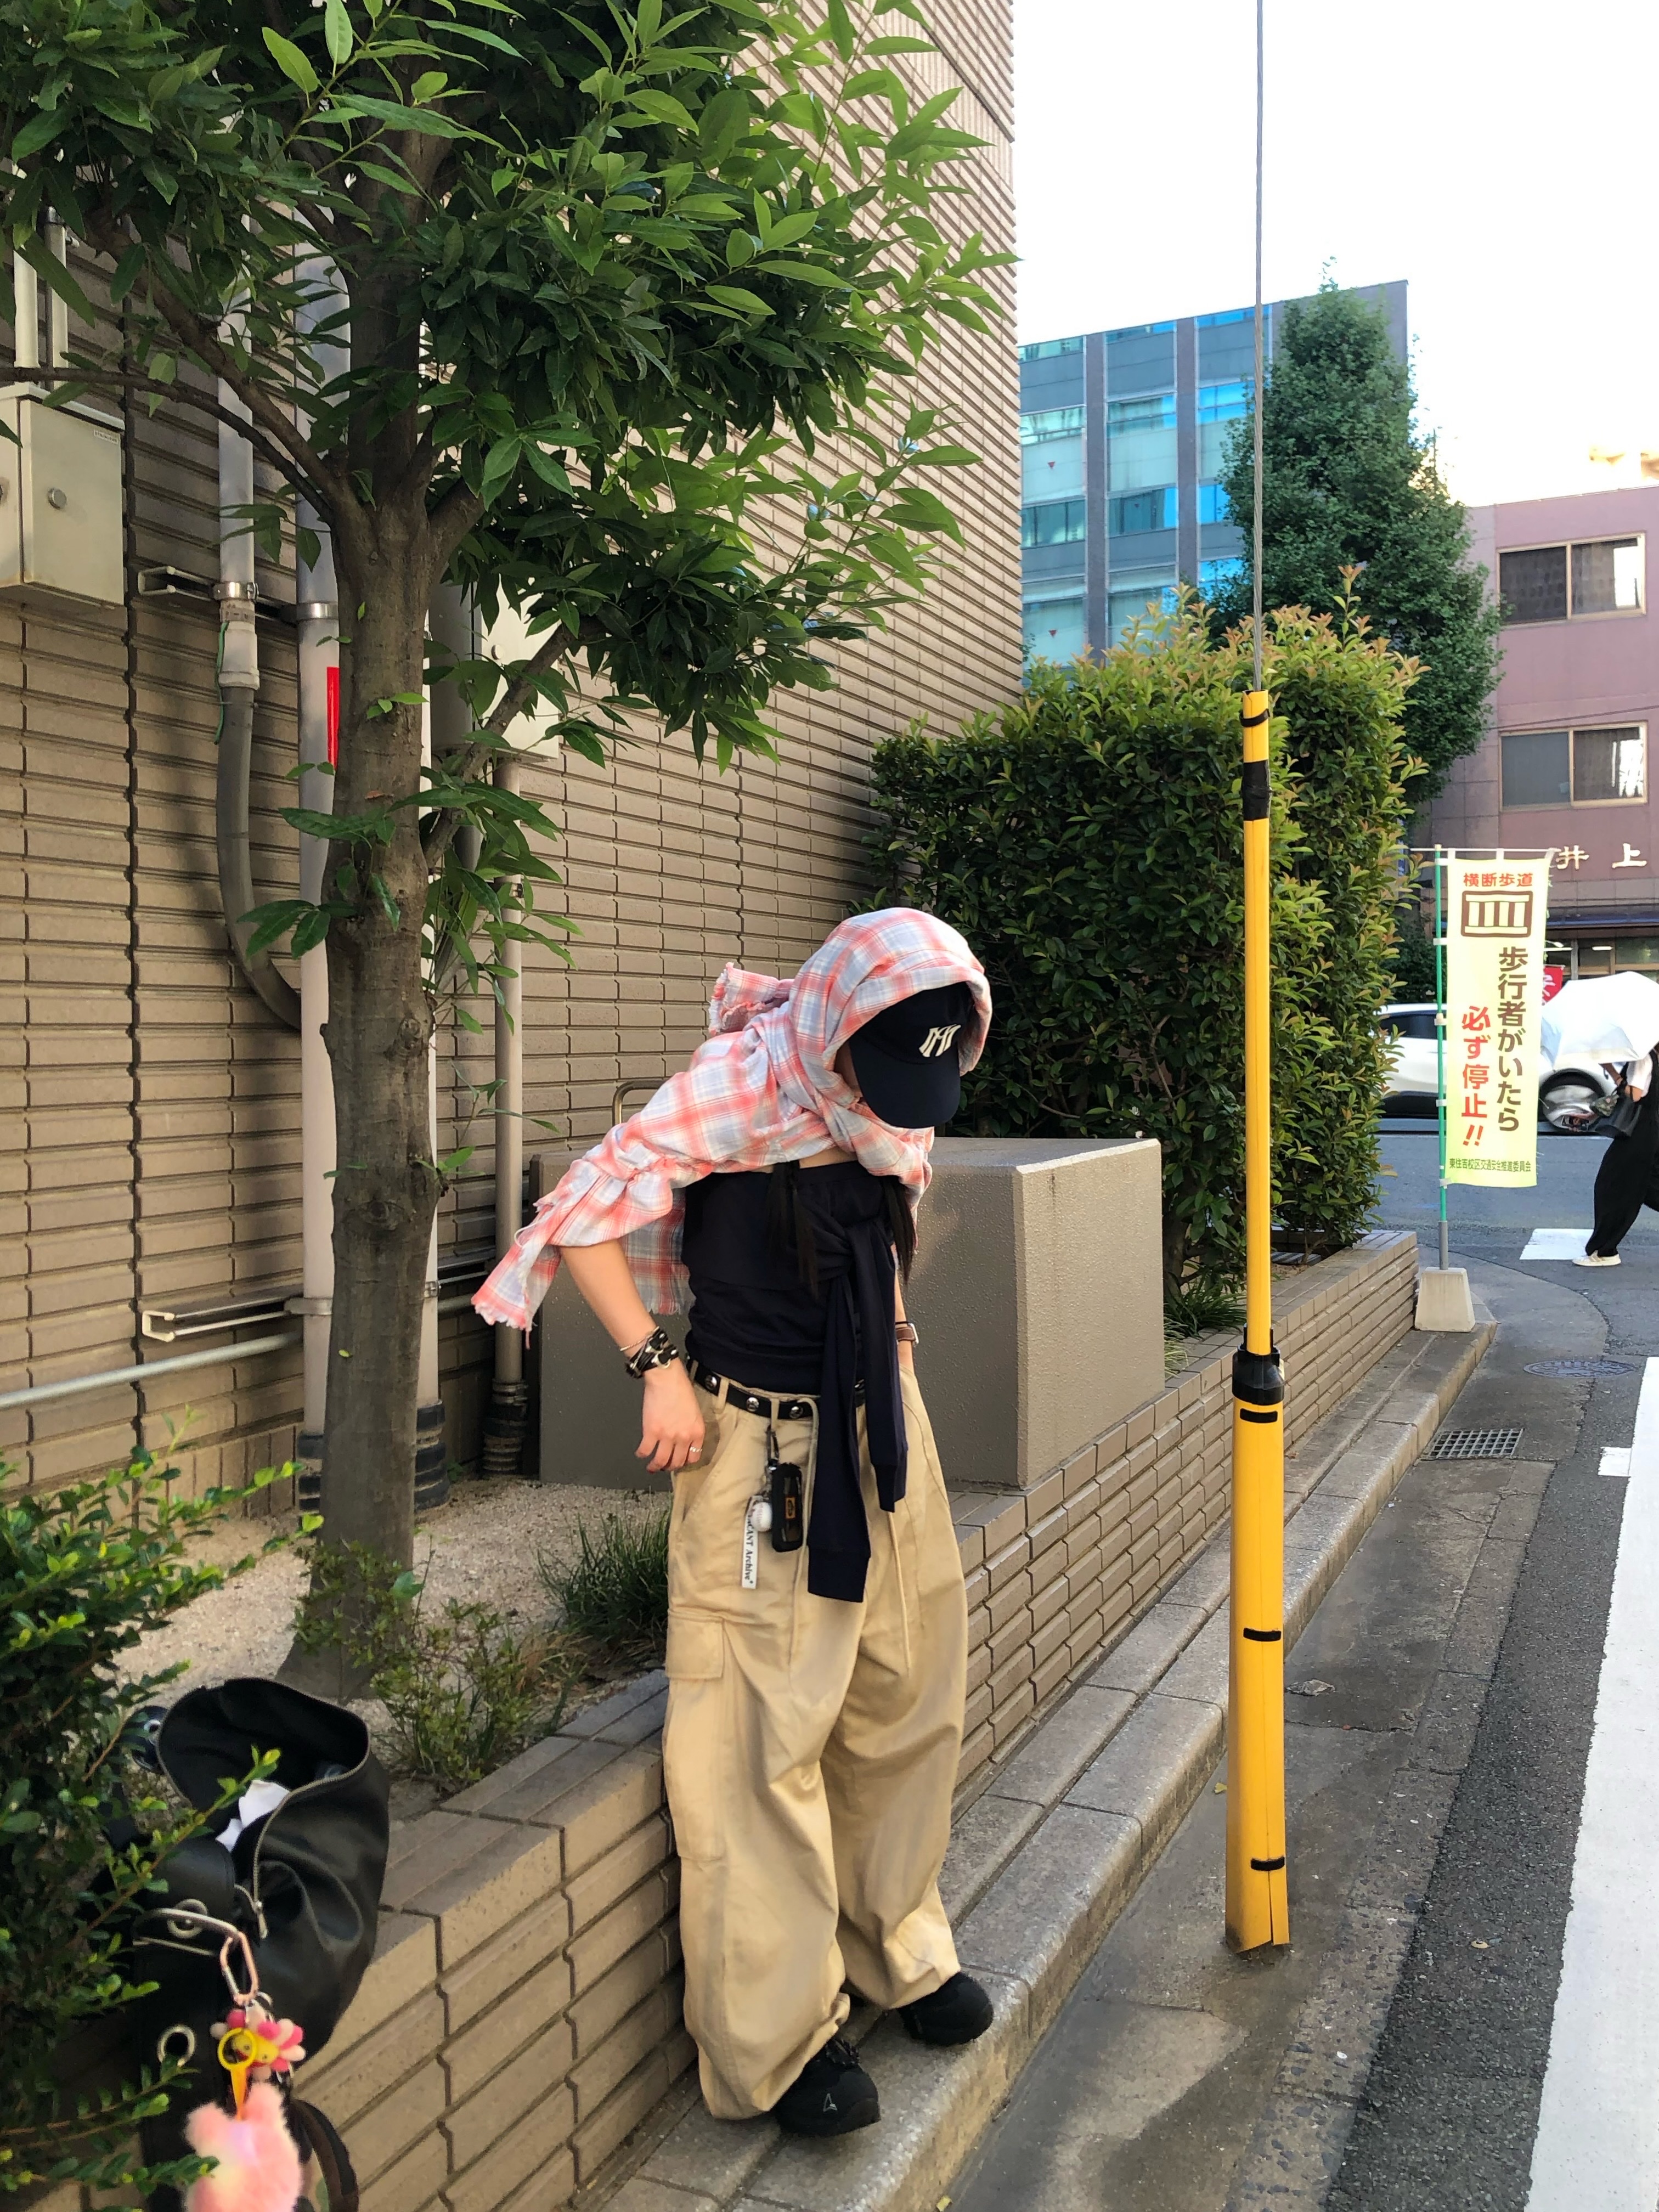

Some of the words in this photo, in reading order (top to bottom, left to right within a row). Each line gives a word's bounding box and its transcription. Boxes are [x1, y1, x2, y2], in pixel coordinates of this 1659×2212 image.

[1555, 843, 1647, 870] 井上
[1463, 872, 1533, 887] 横断歩道
[1497, 946, 1528, 1132] 歩行者がいたら
[746, 1513, 754, 1546] CANT
